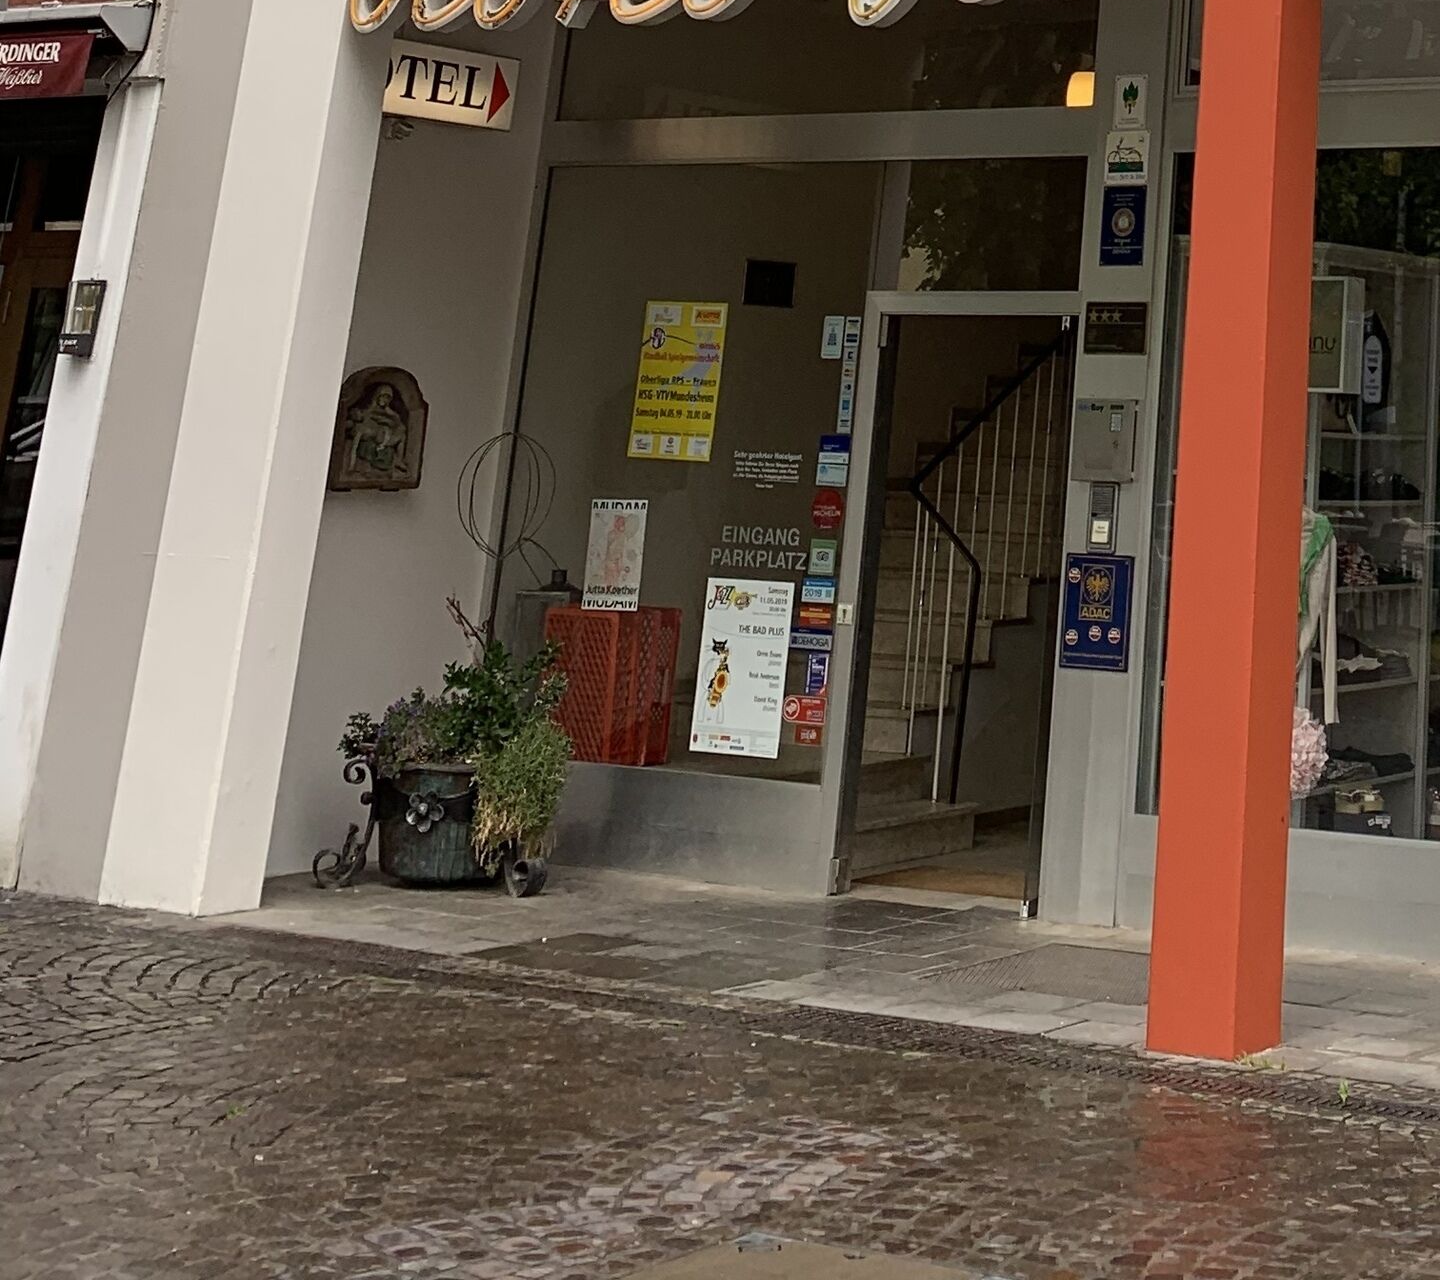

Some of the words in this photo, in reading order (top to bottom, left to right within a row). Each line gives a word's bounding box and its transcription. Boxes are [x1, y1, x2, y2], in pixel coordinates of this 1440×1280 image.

[0, 42, 61, 65] RDINGER
[1309, 336, 1337, 351] nu
[721, 525, 801, 547] EINGANG
[710, 548, 808, 571] PARKPLATZ
[585, 584, 605, 595] Jutta
[804, 588, 823, 598] 2019
[1080, 606, 1111, 620] ADAC
[738, 624, 751, 634] THE
[752, 626, 767, 635] BAD
[768, 627, 785, 637] PLUS
